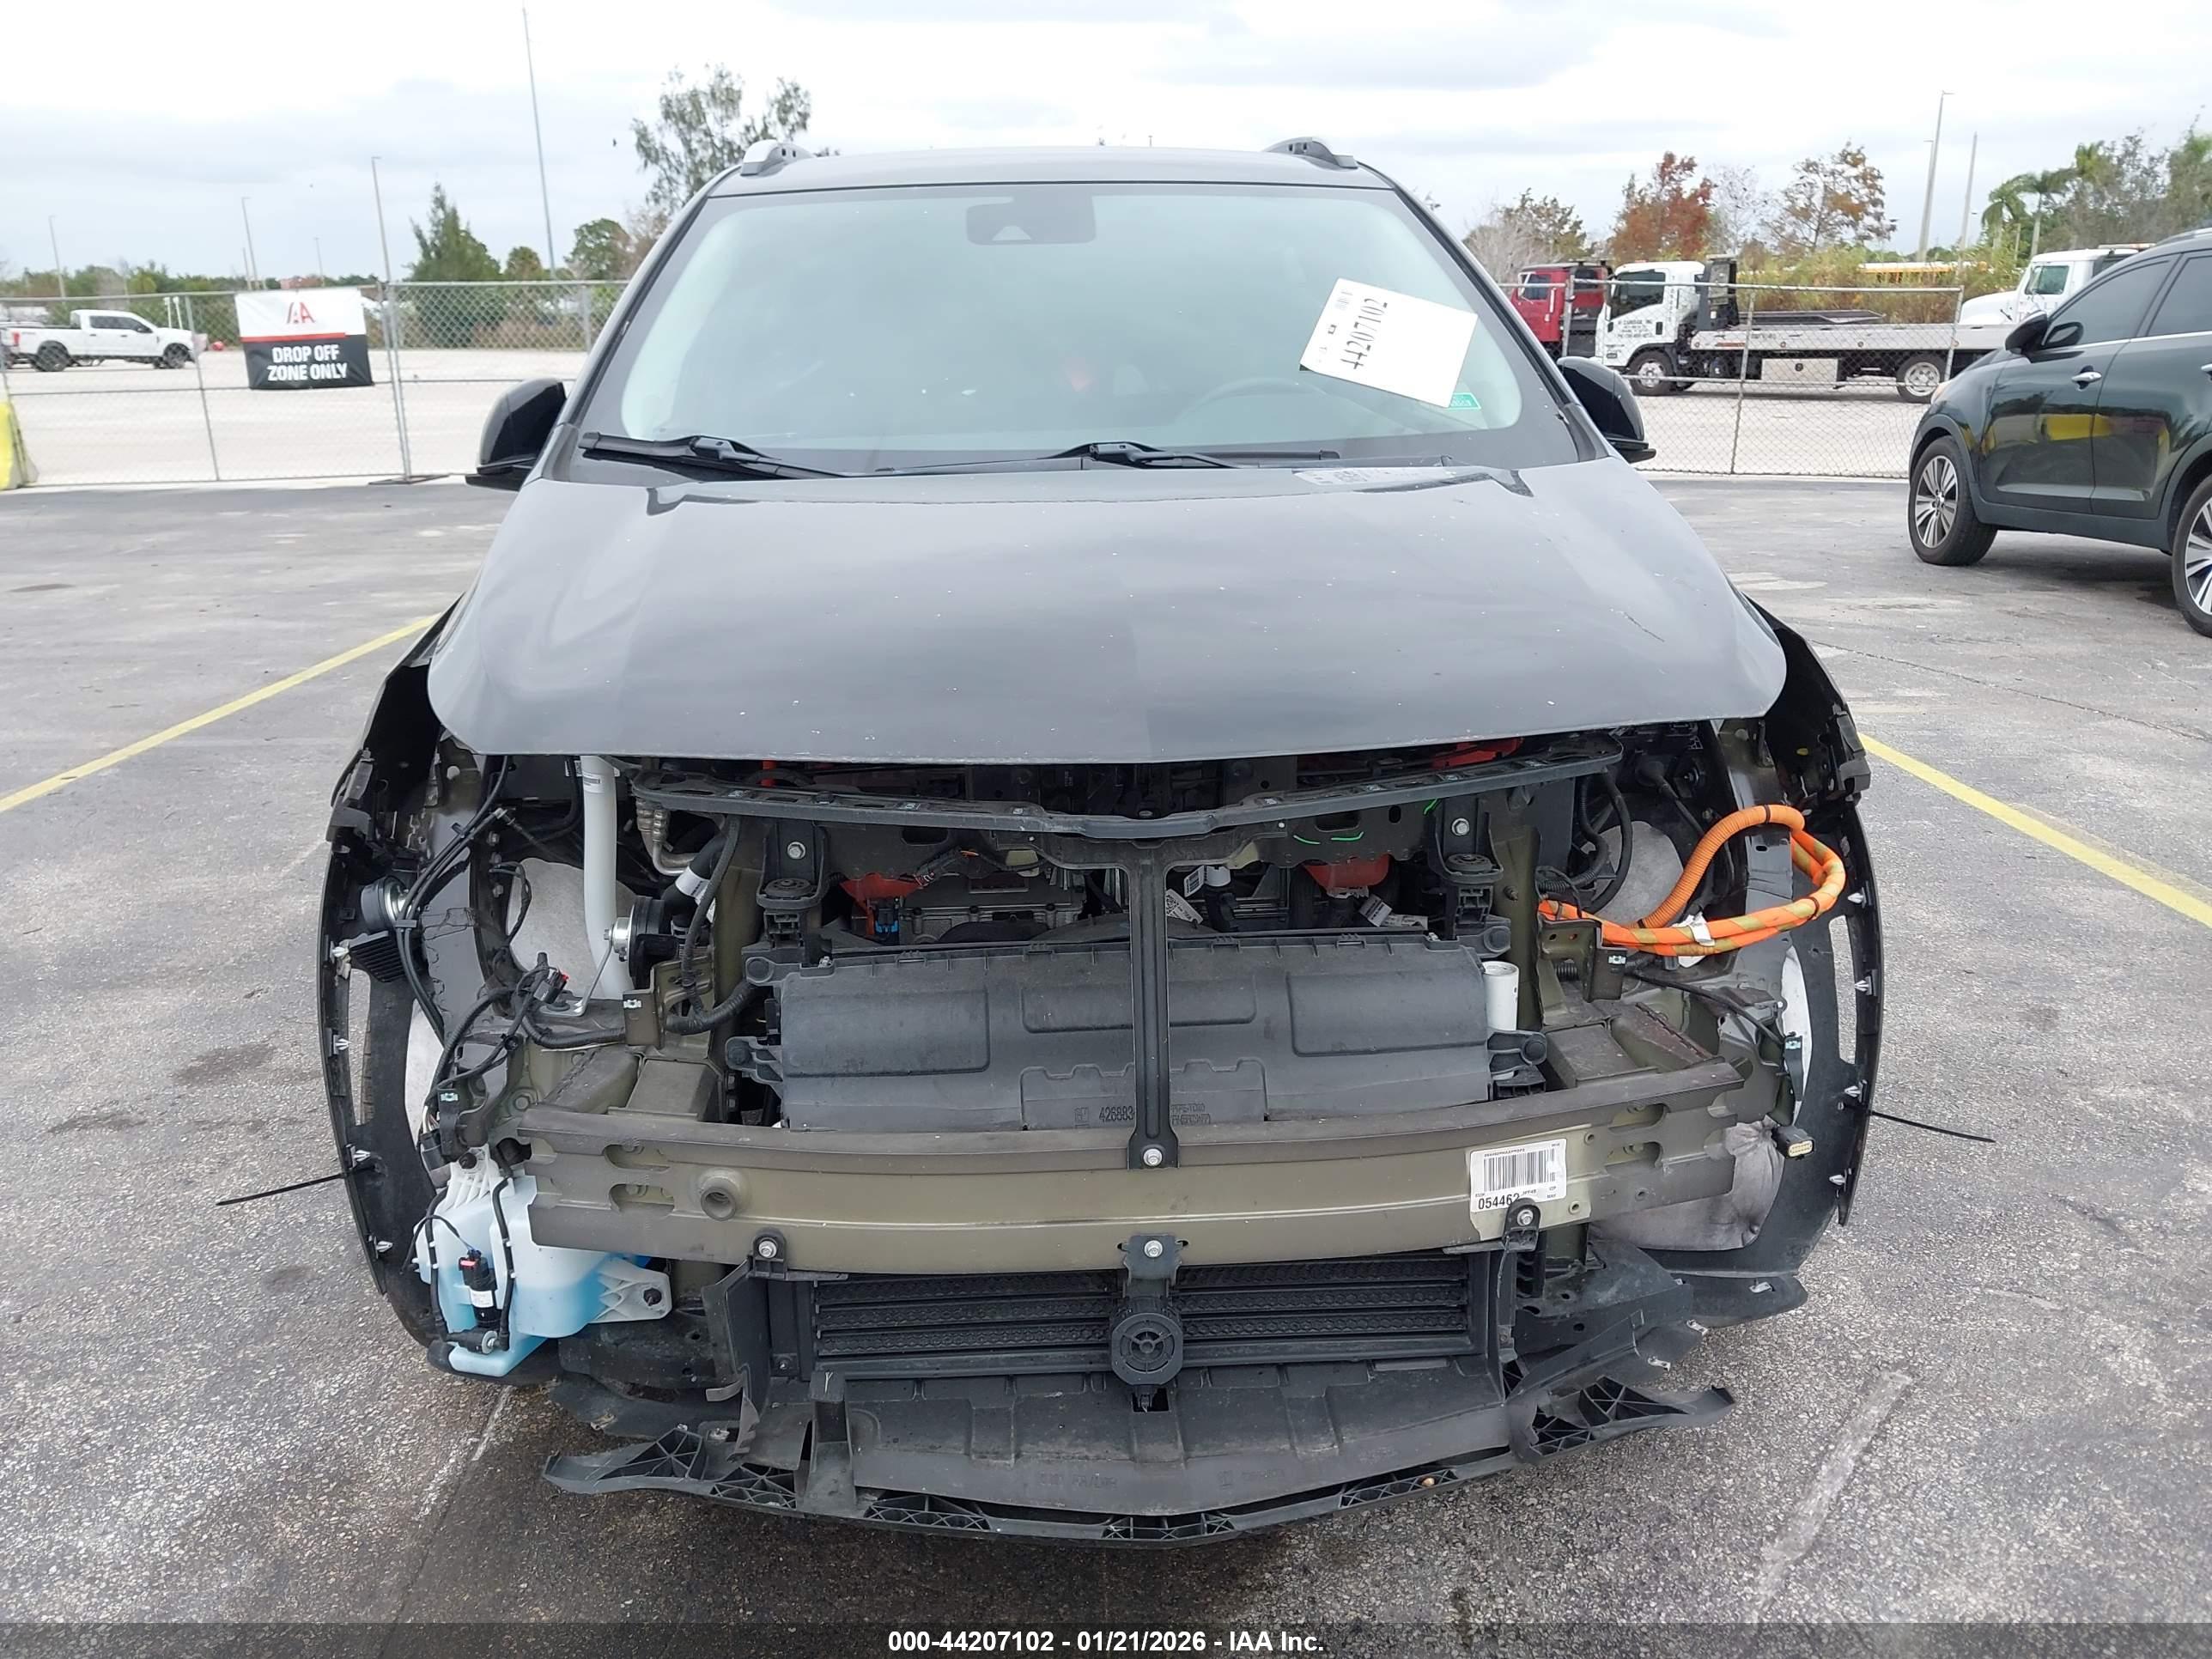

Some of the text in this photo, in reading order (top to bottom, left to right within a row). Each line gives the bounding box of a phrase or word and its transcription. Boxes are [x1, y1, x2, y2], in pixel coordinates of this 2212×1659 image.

[1340, 298, 1388, 369] 44207102
[272, 344, 340, 363] DROP OFF
[266, 363, 348, 381] ZONE ONLY
